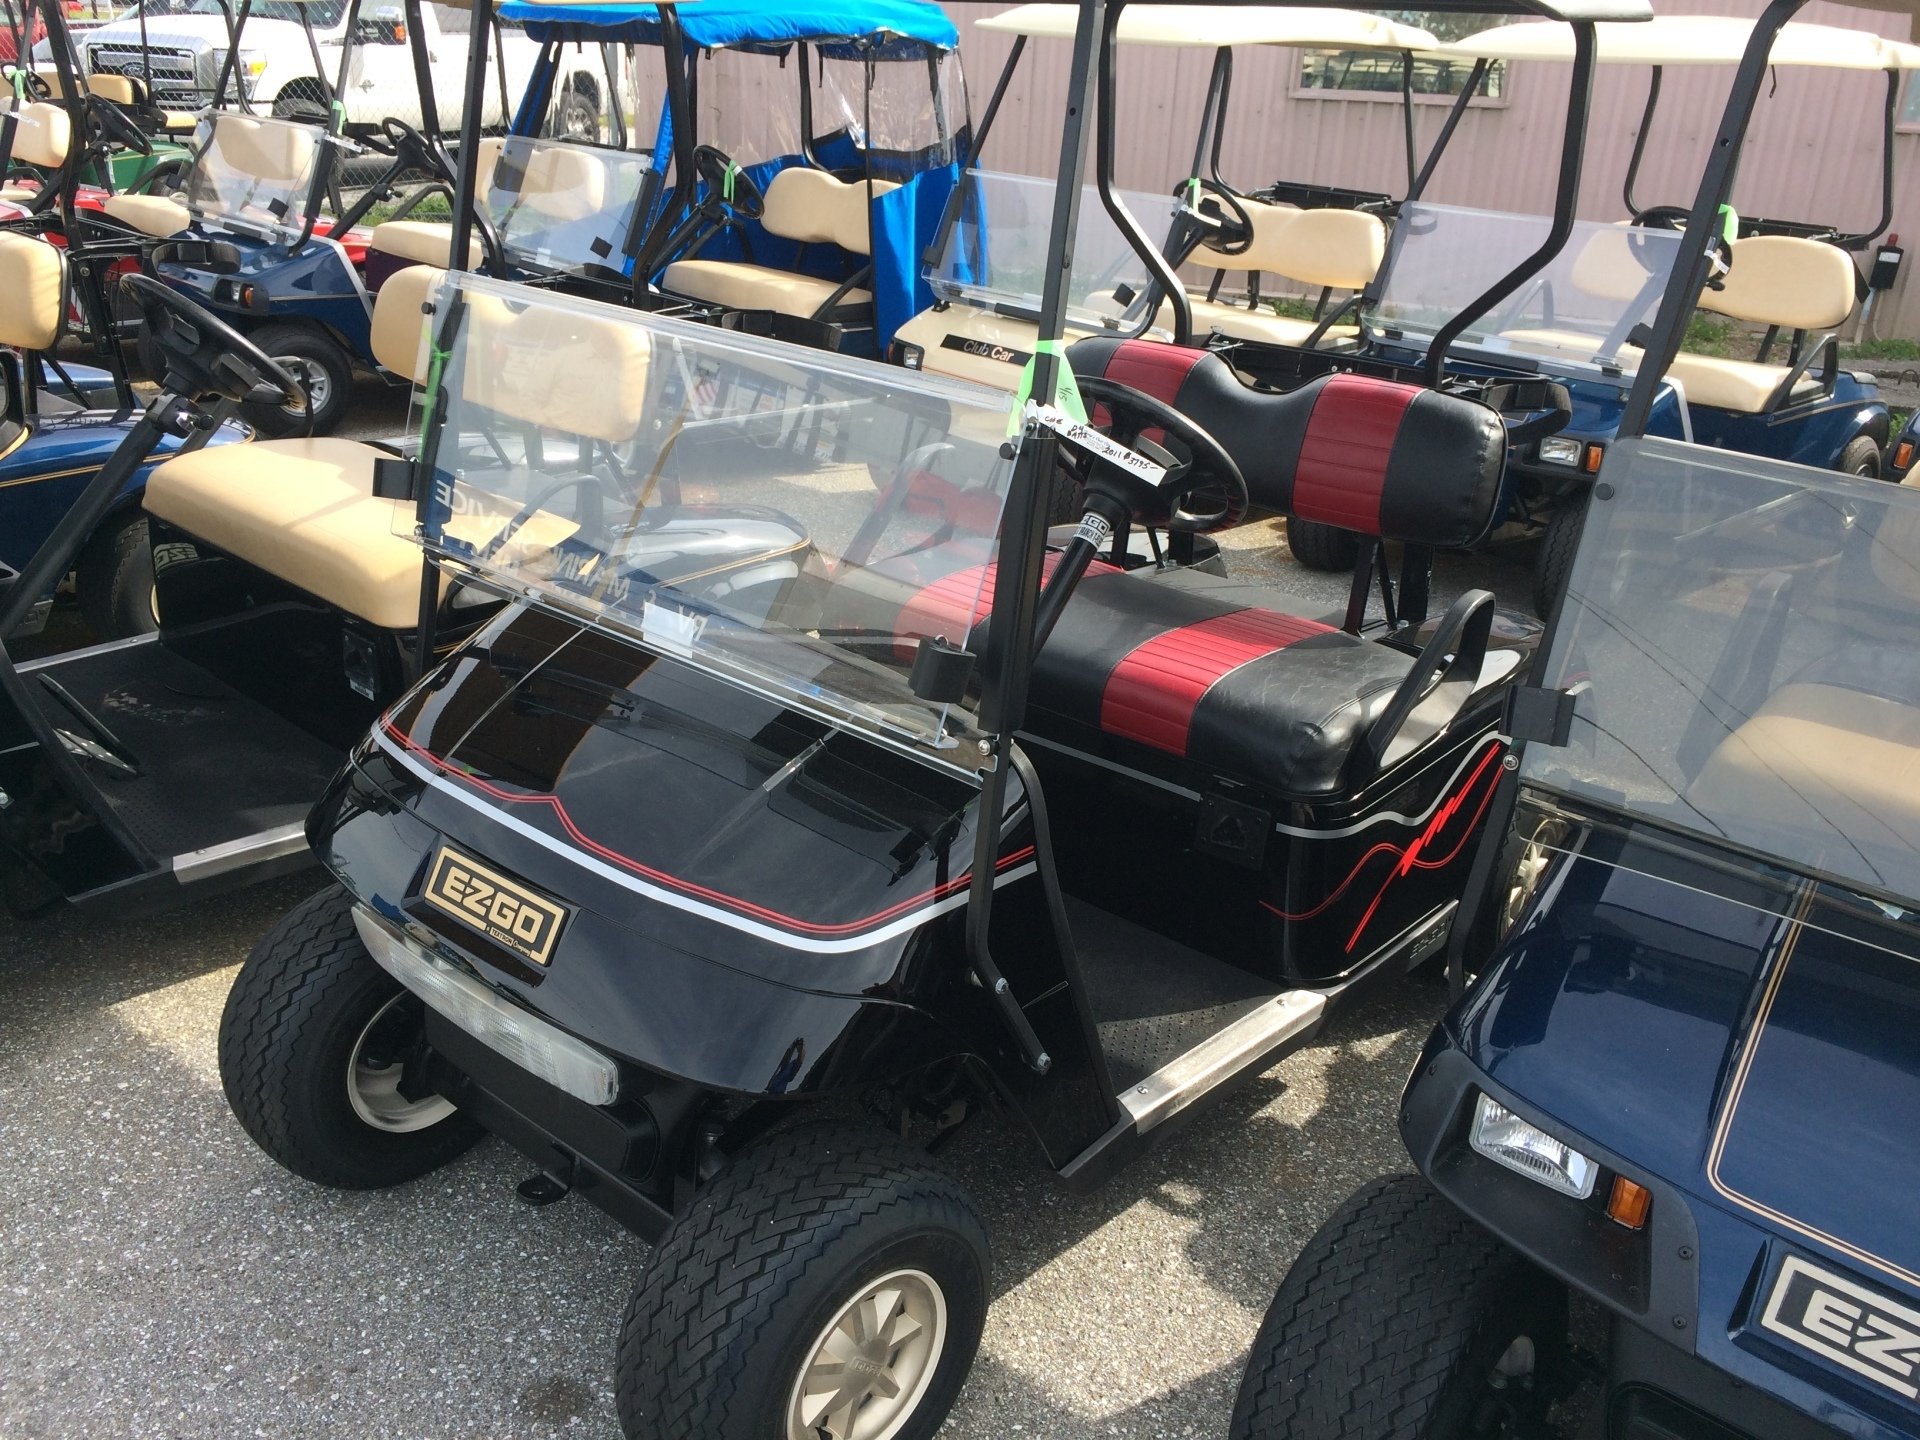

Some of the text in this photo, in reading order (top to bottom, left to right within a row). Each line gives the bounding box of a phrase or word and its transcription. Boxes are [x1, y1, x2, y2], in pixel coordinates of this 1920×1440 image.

[963, 340, 1015, 362] Club Car
[490, 928, 513, 946] TEXTRON
[1802, 1289, 1920, 1380] EZ
